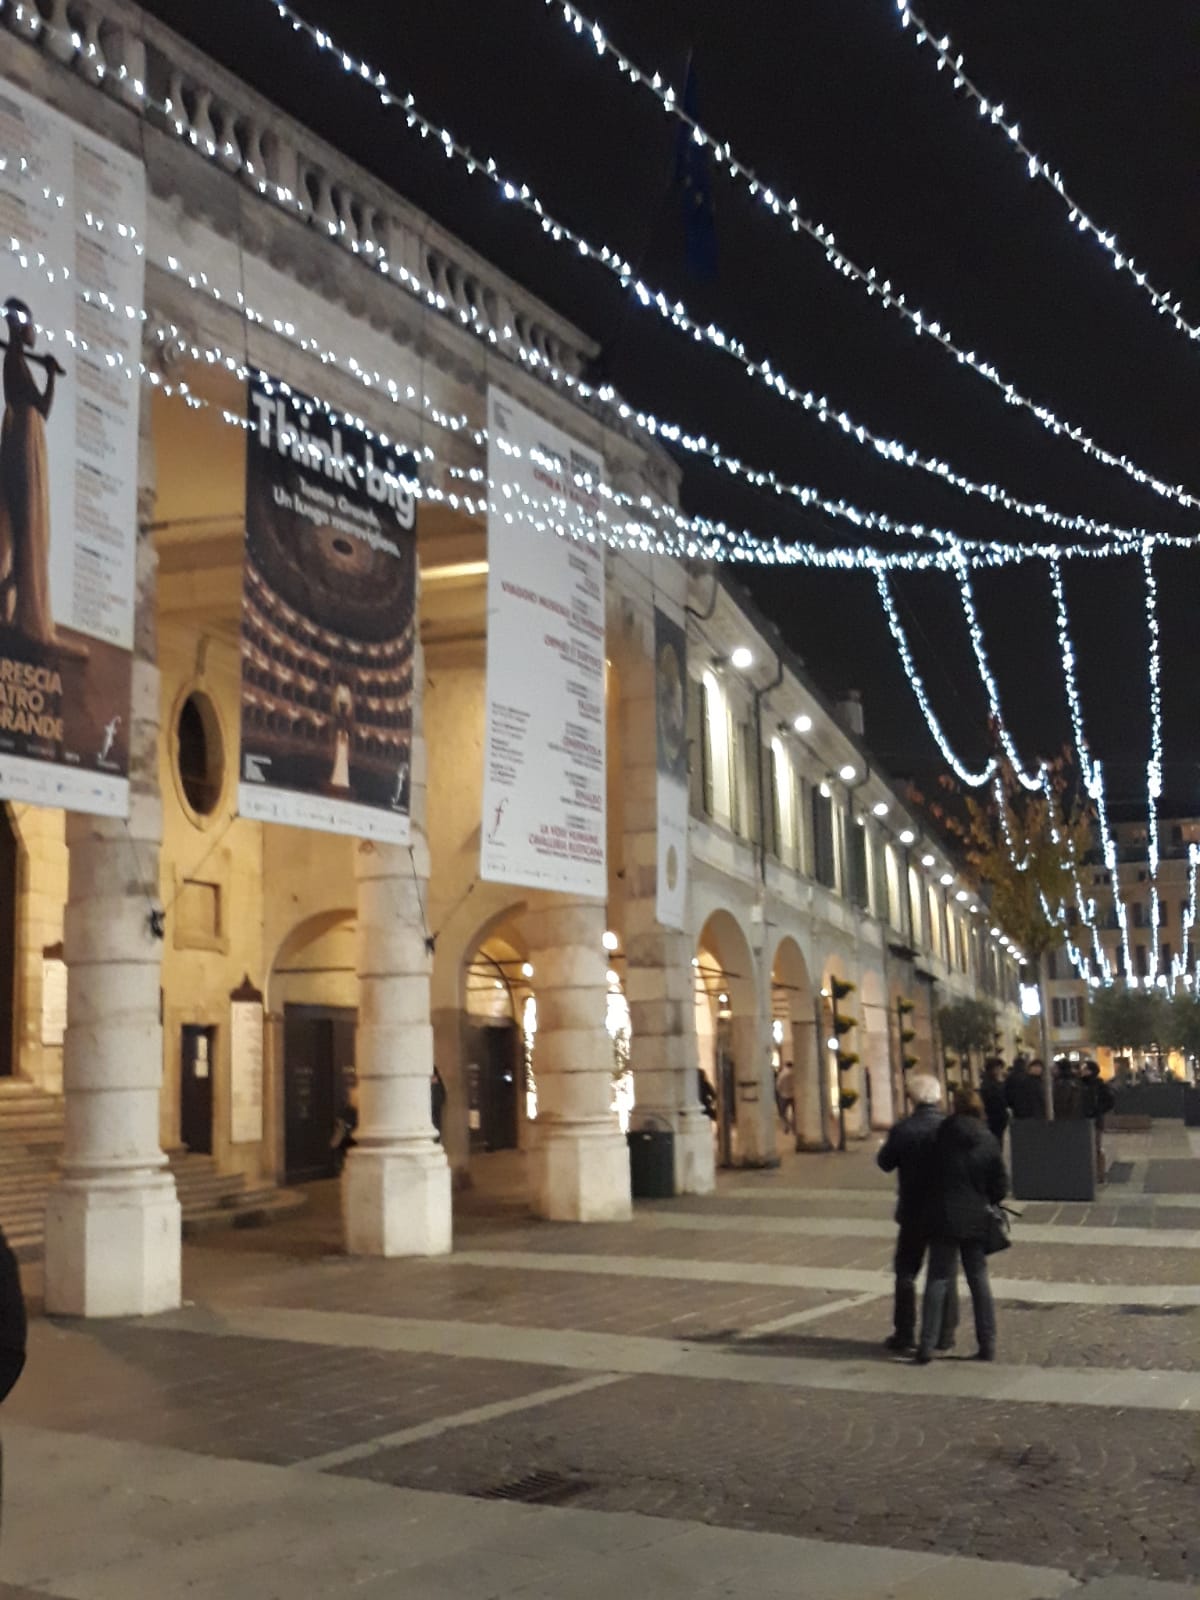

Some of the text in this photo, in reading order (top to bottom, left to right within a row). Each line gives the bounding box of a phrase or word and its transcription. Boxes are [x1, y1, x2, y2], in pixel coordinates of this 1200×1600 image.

[251, 391, 415, 531] Think big
[273, 484, 292, 509] Un
[0, 658, 63, 696] RESCIA
[0, 707, 64, 742] RANDE
